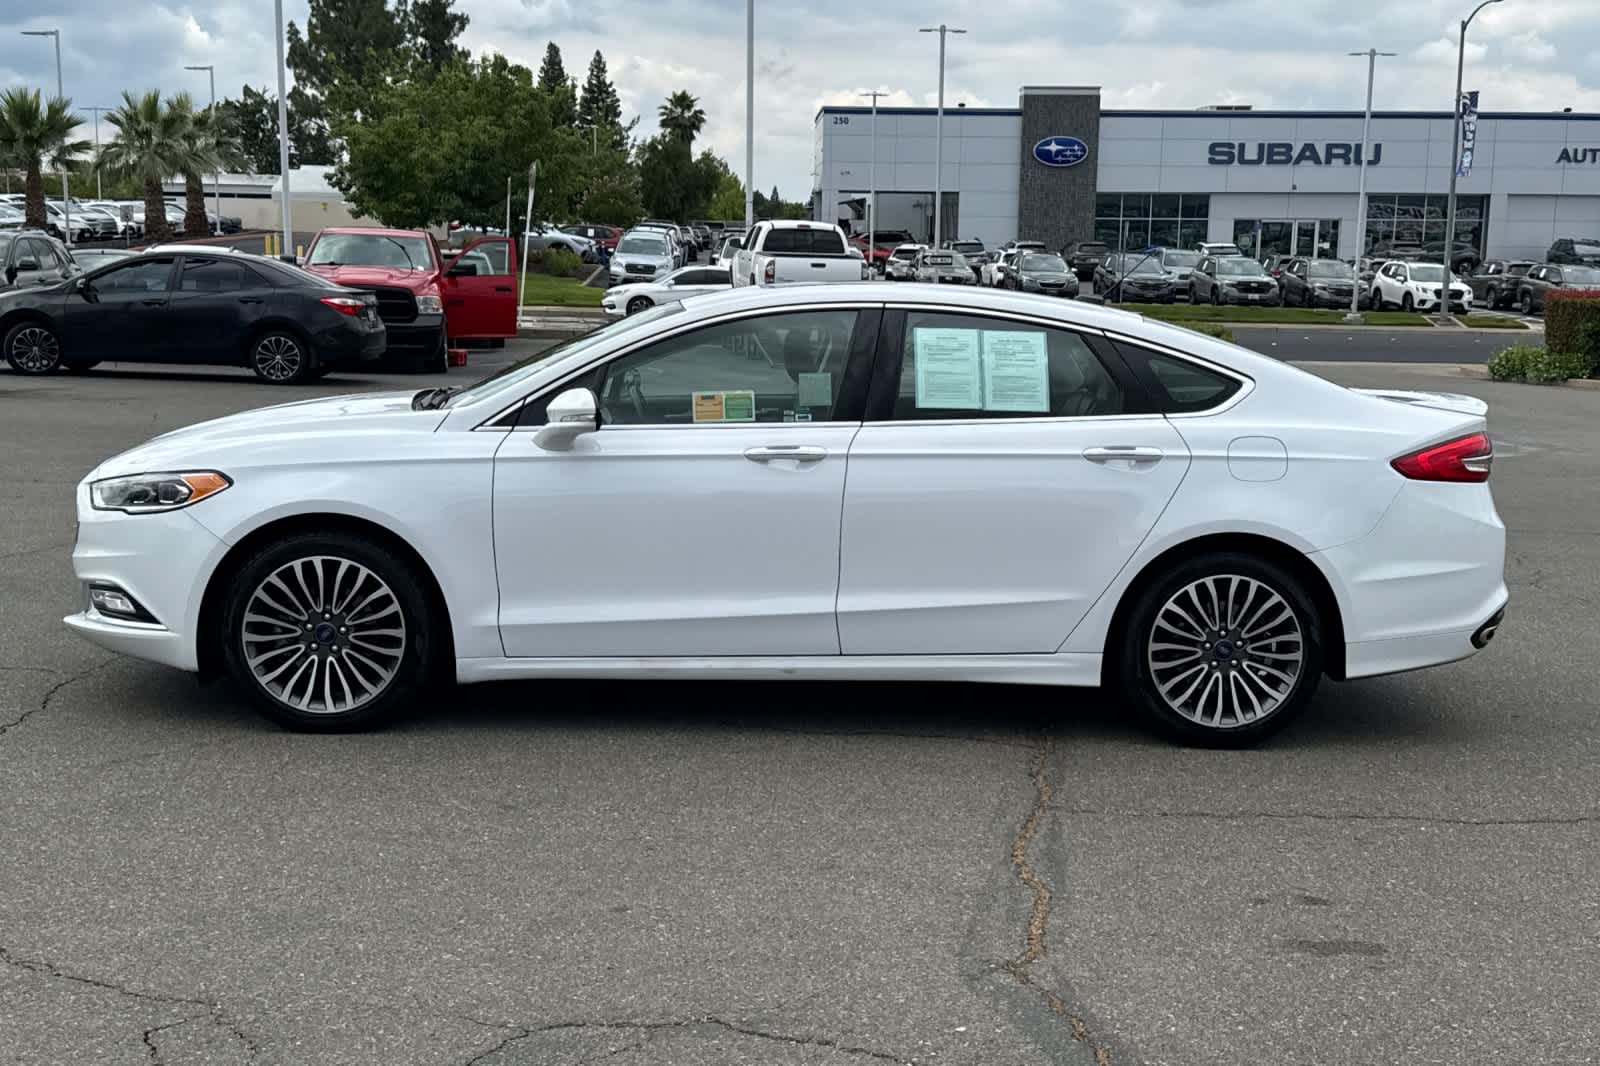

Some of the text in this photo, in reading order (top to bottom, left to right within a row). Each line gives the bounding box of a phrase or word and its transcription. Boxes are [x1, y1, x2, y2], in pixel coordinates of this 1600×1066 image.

[832, 116, 850, 125] 250
[1208, 142, 1382, 165] SUBARU
[1555, 148, 1600, 164] AUT
